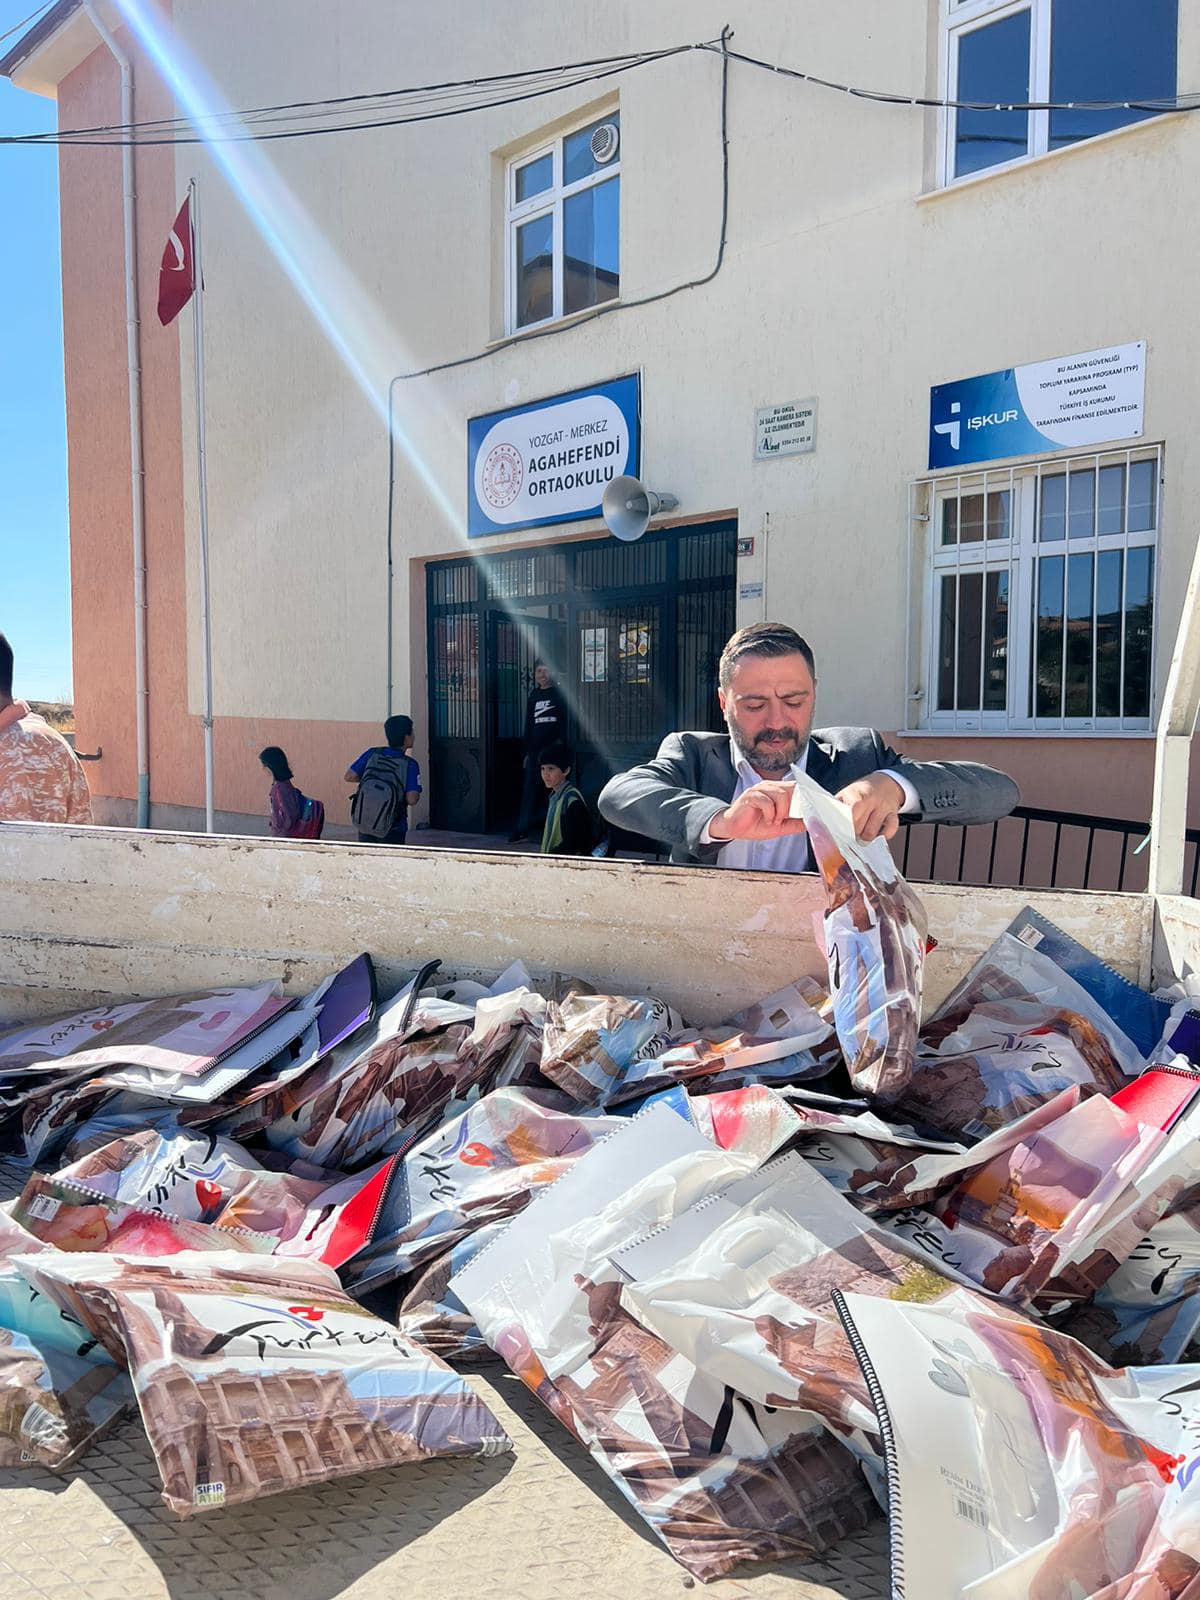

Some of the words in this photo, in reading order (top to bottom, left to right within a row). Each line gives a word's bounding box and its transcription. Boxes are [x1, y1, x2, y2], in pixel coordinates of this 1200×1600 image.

[1092, 367, 1123, 379] PROGRAM
[529, 430, 563, 448] YOZGAT
[570, 420, 608, 439] MERKEZ
[528, 435, 620, 474] AGAHEFENDİ
[528, 465, 614, 497] ORTAOKULU
